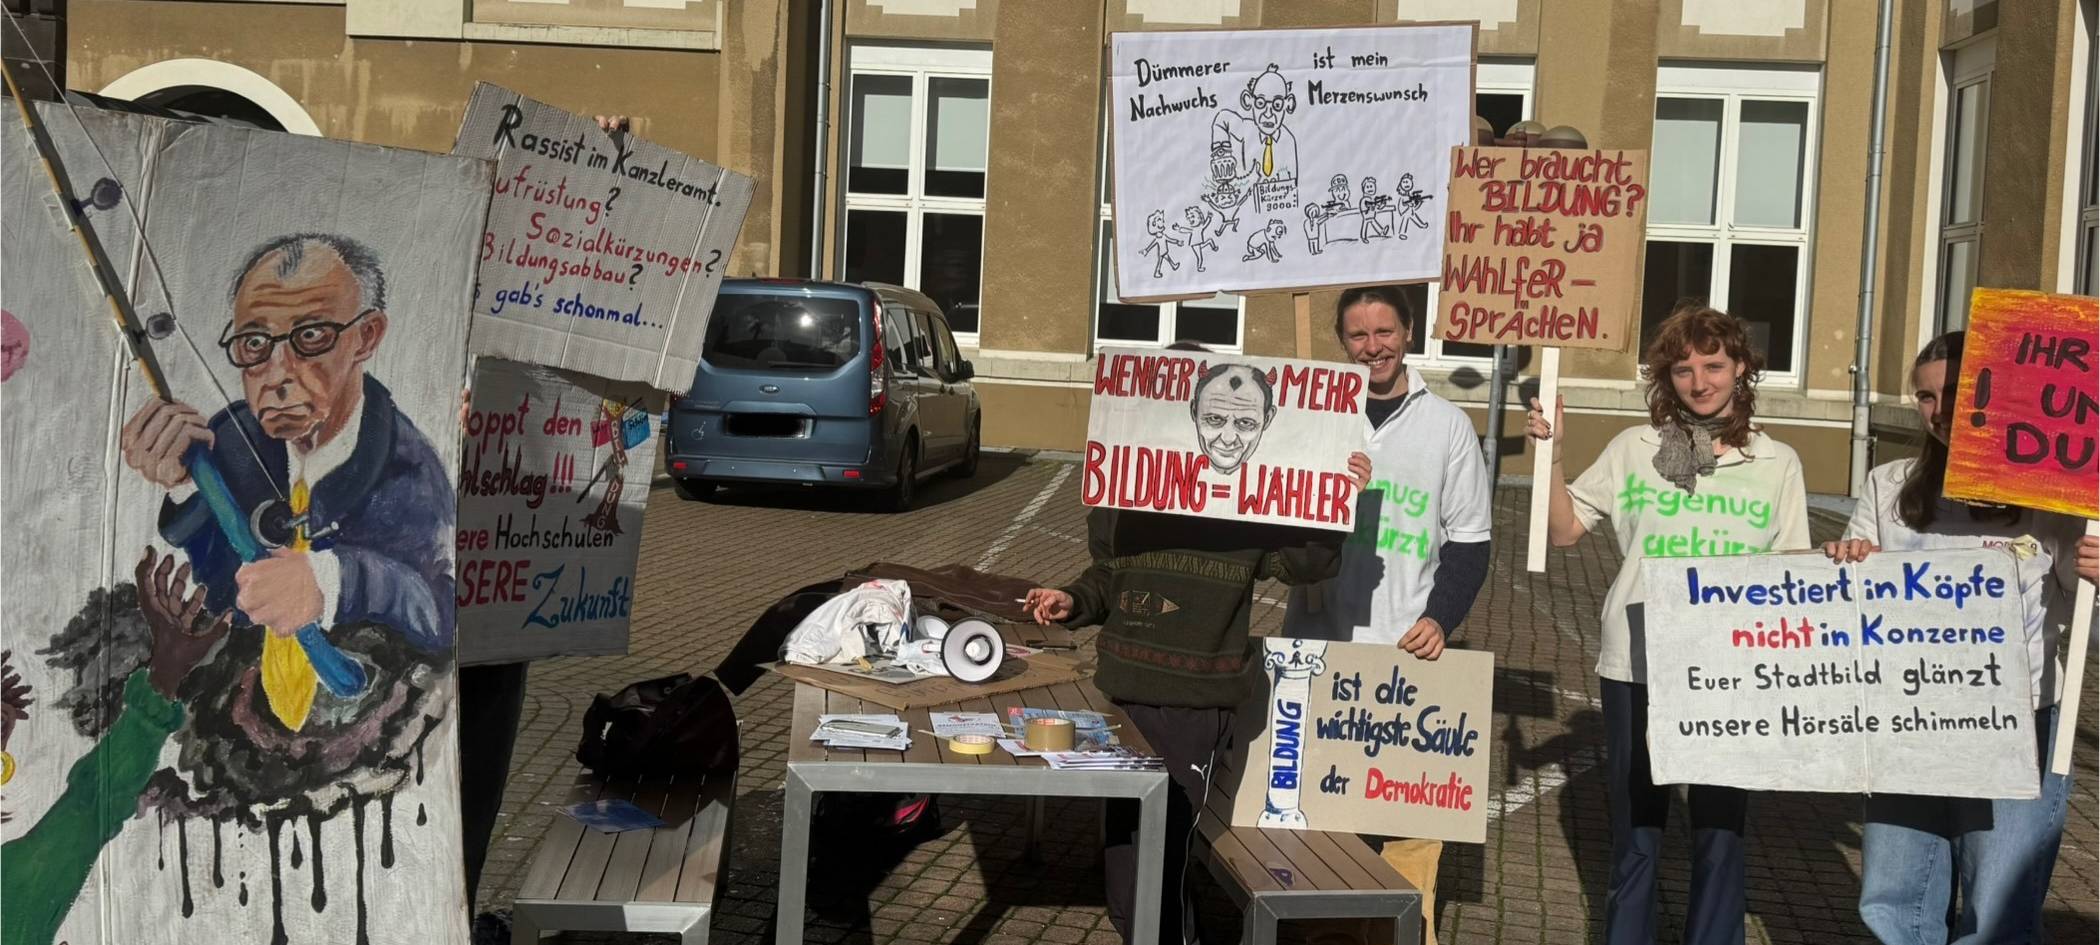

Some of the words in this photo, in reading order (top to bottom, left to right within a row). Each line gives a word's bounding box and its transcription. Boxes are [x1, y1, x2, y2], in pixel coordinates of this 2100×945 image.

[1133, 58, 1231, 87] Dümmerer
[1313, 46, 1336, 70] ist
[1352, 51, 1388, 68] mein
[1130, 86, 1218, 122] Nachwuchs
[1308, 80, 1428, 106] Merzenswunsch
[493, 104, 585, 165] Rassist
[587, 147, 608, 170] im
[612, 145, 721, 207] Kanzleramt.
[1454, 148, 1506, 179] Wer
[1520, 149, 1632, 186] braucht
[495, 165, 621, 225] ufrüstung?
[1479, 180, 1645, 218] BILDUNG?
[526, 212, 721, 278] Sozialkürzungen?
[1450, 211, 1484, 244] Ihr
[1493, 215, 1556, 248] habt
[1563, 223, 1604, 253] ja
[483, 232, 643, 290] Bildungsabbau?
[491, 281, 543, 314] gab's
[2015, 332, 2090, 373] IHR
[1094, 353, 1195, 401] WENIGER
[1278, 364, 1362, 414] MEHR
[467, 392, 529, 454] oppt
[543, 397, 581, 436] den
[2006, 422, 2099, 470] DU
[459, 441, 574, 509] hlschlag!!!
[1083, 440, 1210, 513] BILDUNG
[1238, 462, 1353, 525] WÄHLER
[1617, 472, 1771, 529] #genug
[456, 529, 488, 551] ere
[495, 513, 613, 549] Hochschulen
[456, 559, 530, 607] SERE
[521, 563, 630, 629] Zukunft
[1687, 567, 1853, 605] Investiert
[1864, 579, 1897, 601] in
[1903, 562, 2005, 609] Köpfe
[1732, 617, 1815, 648] nicht
[1820, 622, 1850, 647] in
[1861, 614, 2005, 646] Konzerne
[1332, 671, 1362, 701] ist
[1375, 665, 1418, 706] die
[1688, 666, 1741, 691] Euer
[1754, 659, 1881, 690] Stadtbild
[1903, 653, 2002, 696] glänzt
[1271, 699, 1302, 789] BILDUNG
[1317, 707, 1411, 757] wichtigste
[1412, 706, 1478, 757] Säule
[1679, 718, 1770, 737] unsere
[1782, 705, 1880, 737] Hörsäle
[1891, 706, 2017, 733] schimmeln
[1320, 764, 1350, 795] der
[1365, 767, 1473, 811] Demokratie
